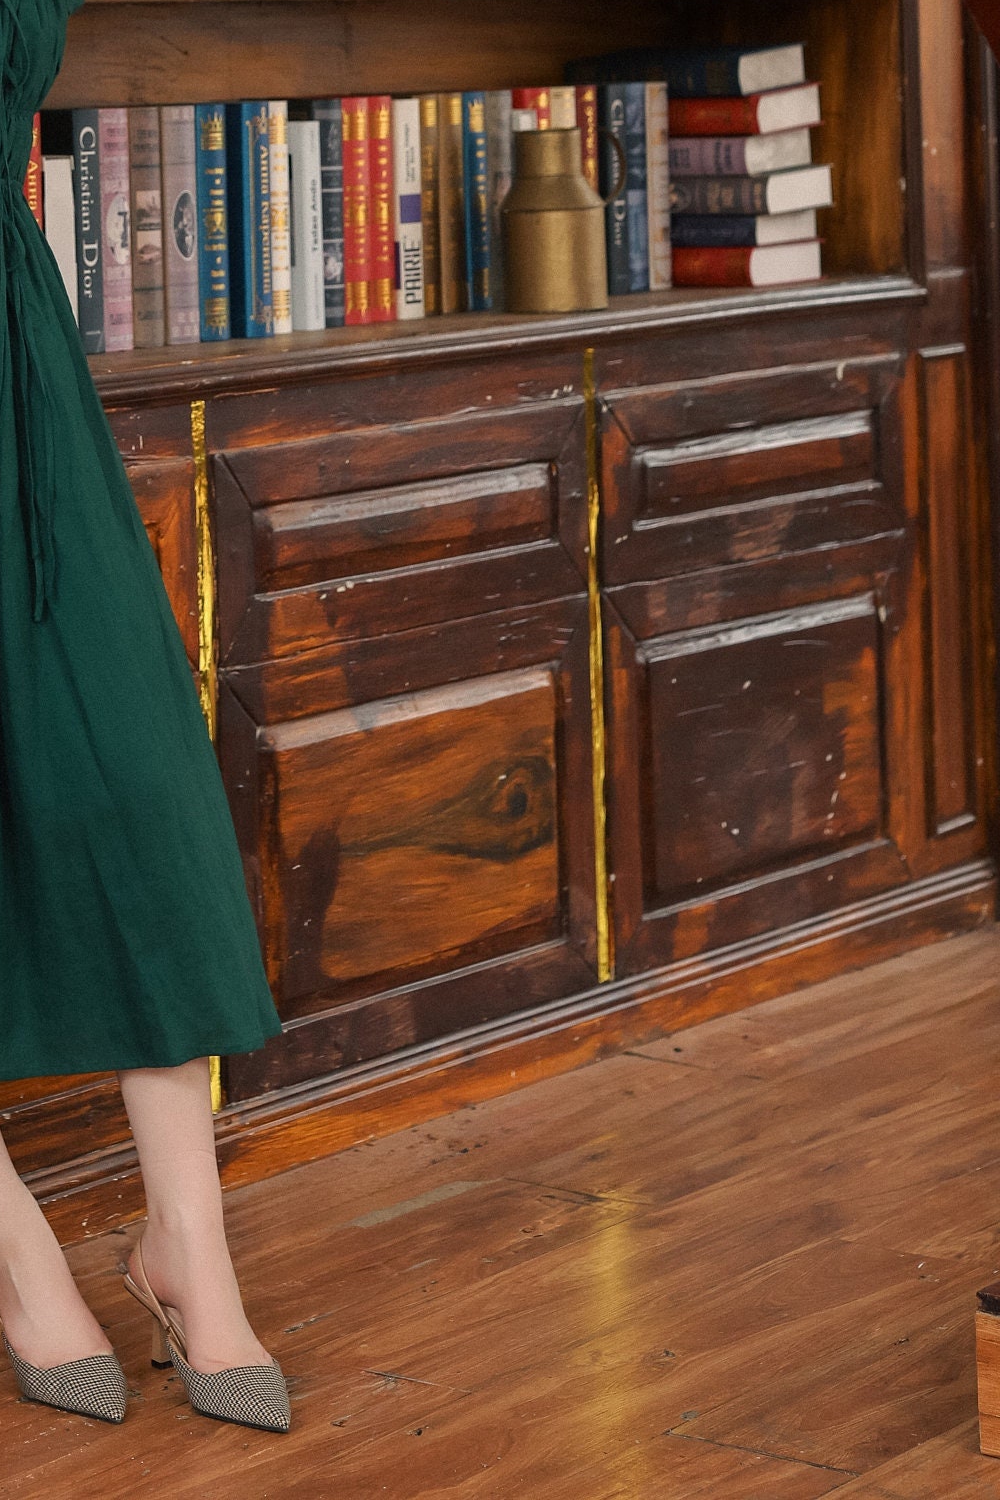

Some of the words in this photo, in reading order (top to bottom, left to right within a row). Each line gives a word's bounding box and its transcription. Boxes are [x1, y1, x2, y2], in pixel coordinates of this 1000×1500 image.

[79, 126, 96, 232] Christian
[259, 145, 269, 194] Анна
[81, 240, 99, 298] Dior
